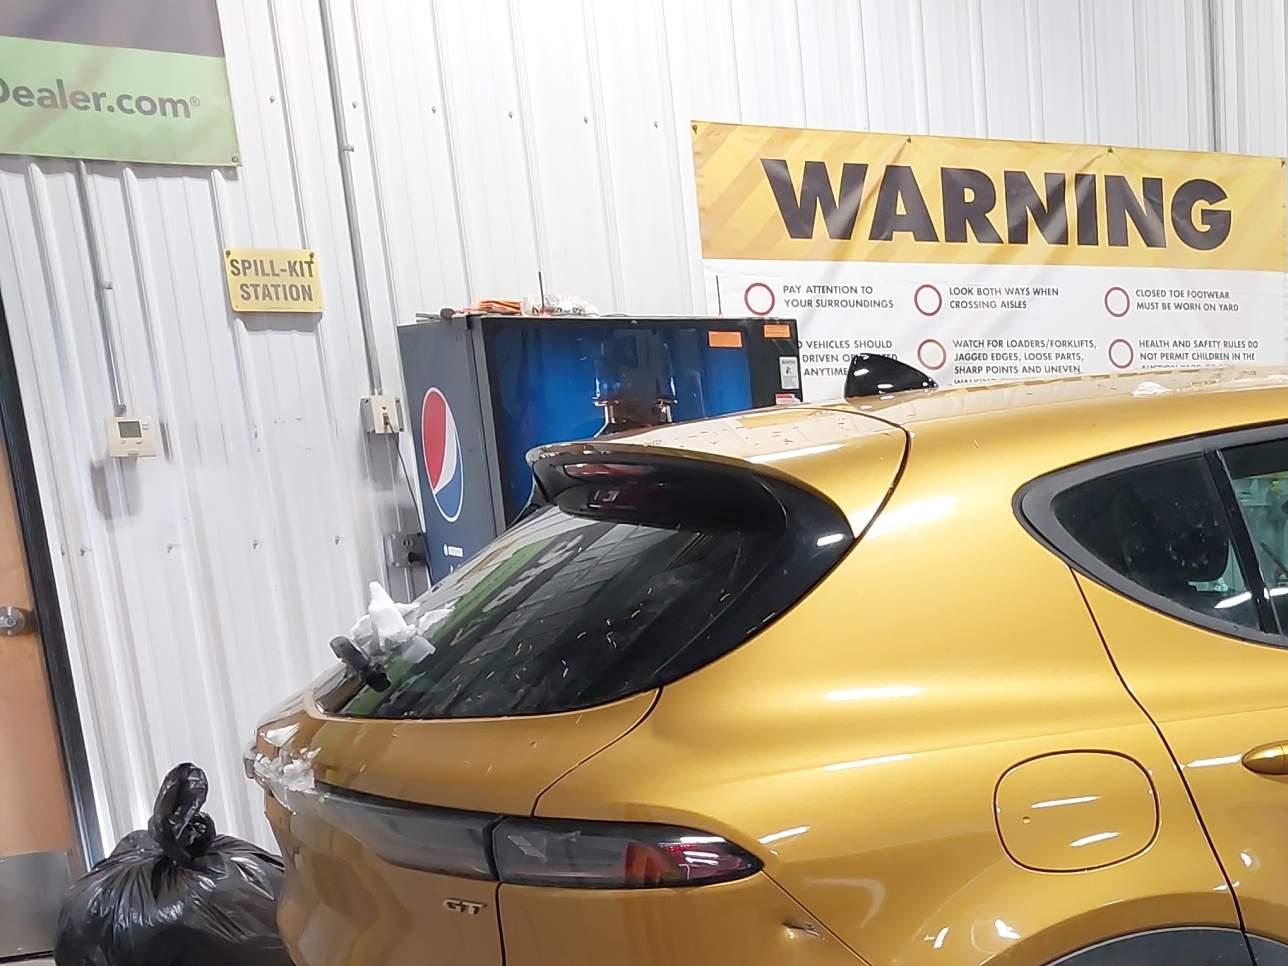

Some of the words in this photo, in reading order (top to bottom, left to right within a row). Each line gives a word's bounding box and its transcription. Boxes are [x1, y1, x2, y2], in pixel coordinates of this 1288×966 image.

[760, 158, 1232, 250] WARNING
[230, 258, 314, 278] SPILL-KIT
[240, 283, 313, 301] STATION
[783, 285, 801, 294] PAY
[806, 285, 858, 294] ATTENTION
[861, 286, 873, 294] TO
[949, 287, 974, 296] LOOK
[977, 287, 1001, 296] BOTH
[1004, 287, 1030, 296] WAYS
[1032, 287, 1059, 296] WHEN
[1135, 289, 1167, 298] CLOSED
[1169, 289, 1185, 298] TOE
[1187, 290, 1230, 299] FOOTWEAR
[784, 299, 813, 308] YOUR
[815, 299, 894, 309] SURROUNDINGS
[950, 300, 997, 309] CROSSING
[1000, 300, 1027, 309] AISLES
[1136, 302, 1159, 310] MUST
[1161, 302, 1172, 310] BE
[1174, 302, 1201, 311] WORN
[1203, 303, 1216, 311] ON
[1218, 303, 1239, 312] YARD
[806, 340, 850, 349] VEHICLES
[854, 340, 893, 349] SHOULD
[952, 339, 984, 348] WATCH
[986, 340, 1004, 348] FOR
[1006, 339, 1097, 349] LOADERS/FORKLIFTS,
[1139, 339, 1170, 348] HEALTH
[1172, 340, 1191, 348] AND
[1193, 340, 1221, 348] SAFETY
[1223, 340, 1246, 348] RULES
[1248, 340, 1259, 348] DO
[802, 354, 839, 362] DRIVEN
[954, 352, 988, 361] JAGGED
[991, 352, 1021, 362] EDGES,
[1024, 352, 1053, 361] LOOSE
[1055, 352, 1084, 361] PARTS,
[1140, 352, 1158, 360] NOT
[1160, 352, 1190, 360] PERMIT
[1191, 352, 1230, 361] CHILDREN
[1232, 352, 1241, 360] IN
[1242, 352, 1256, 360] THE
[954, 366, 983, 374] SHARP
[986, 365, 1019, 374] POINTS
[1021, 365, 1042, 374] AND
[1044, 365, 1081, 374] UNEVEN
